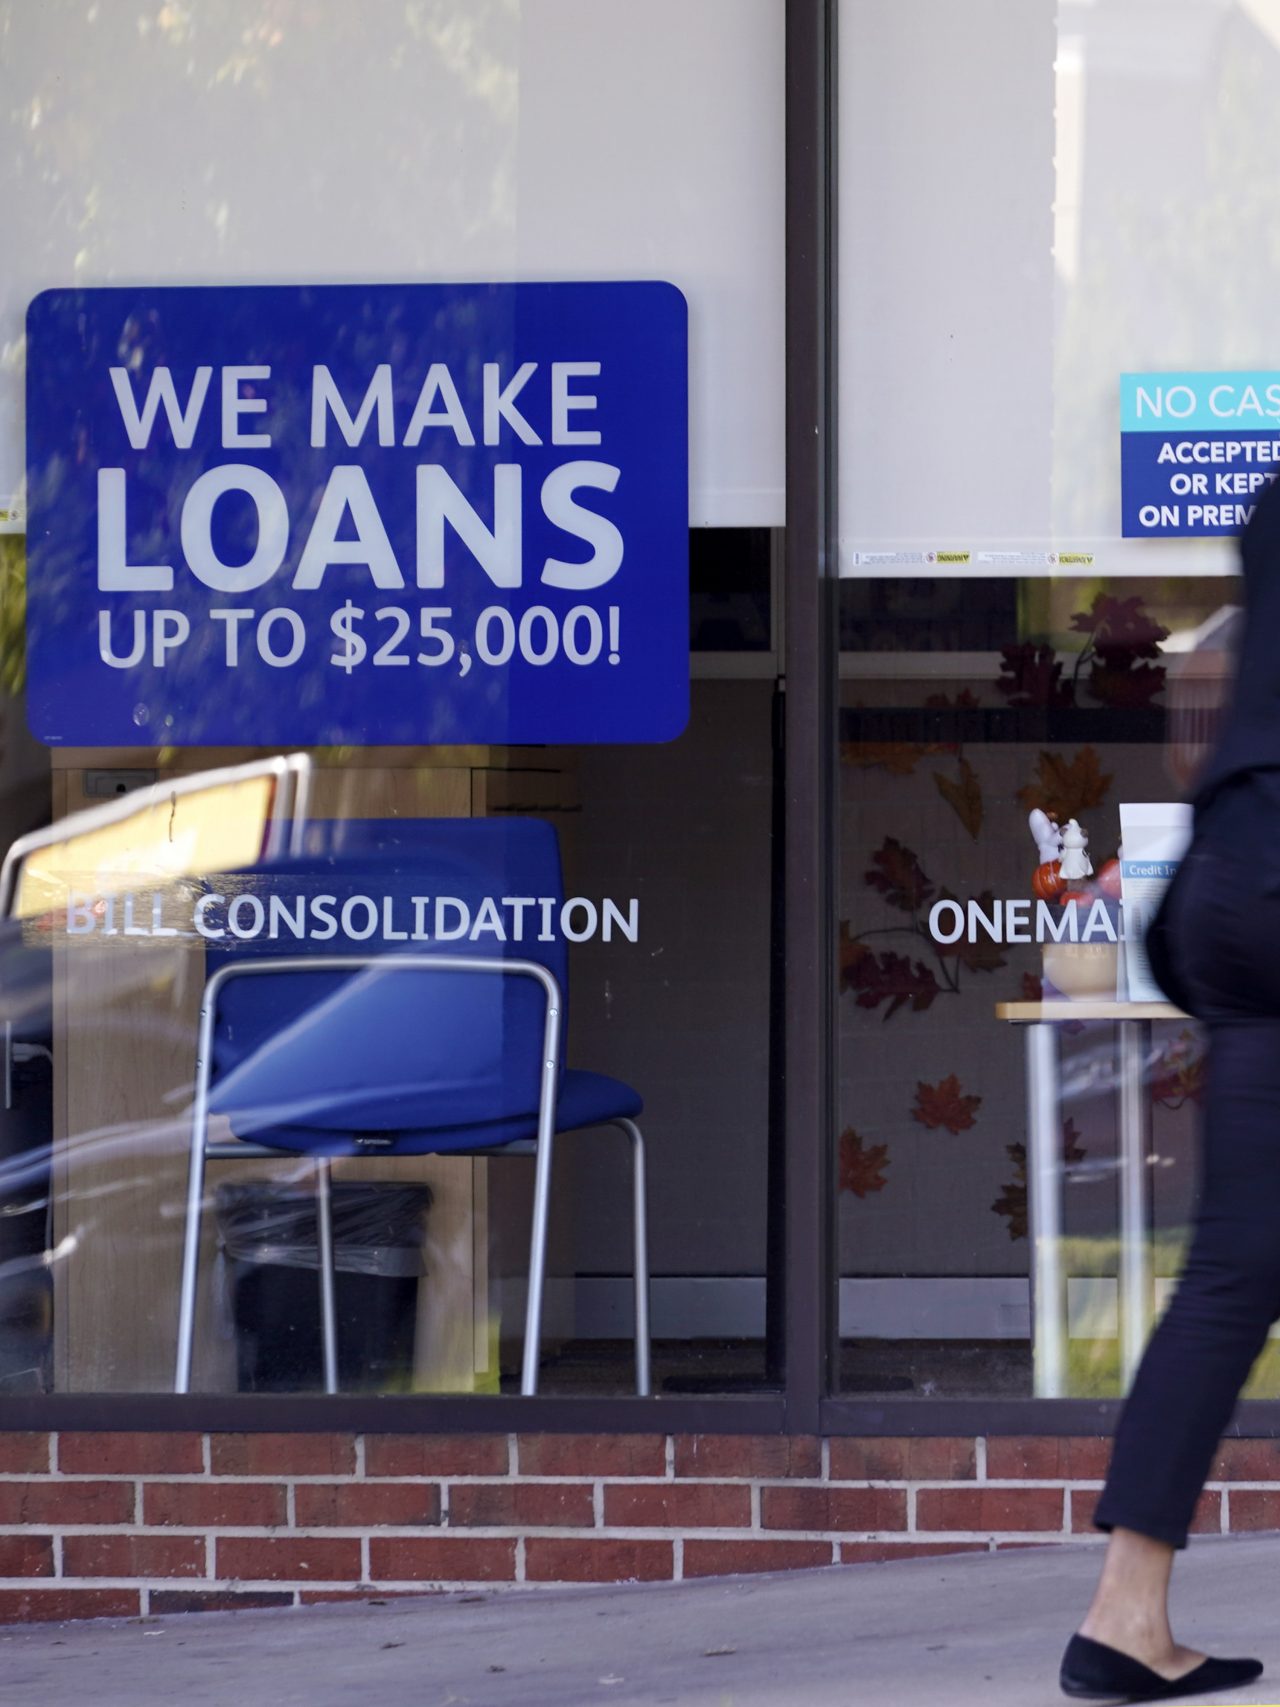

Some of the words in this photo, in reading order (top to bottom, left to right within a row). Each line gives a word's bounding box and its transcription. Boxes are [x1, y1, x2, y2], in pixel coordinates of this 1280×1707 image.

[108, 364, 272, 450] WE
[310, 361, 602, 448] MAKE
[1136, 385, 1197, 418] NO
[1169, 473, 1209, 496] OR
[97, 460, 624, 593] LOANS
[1138, 505, 1180, 527] ON
[1187, 504, 1257, 527] PREM
[98, 609, 190, 669] UP
[209, 607, 306, 668] TO
[329, 599, 621, 678] $25,000!
[1129, 864, 1162, 876] Credit
[1164, 864, 1177, 876] In
[66, 891, 179, 937] BILL
[193, 892, 639, 944] CONSOLIDATION
